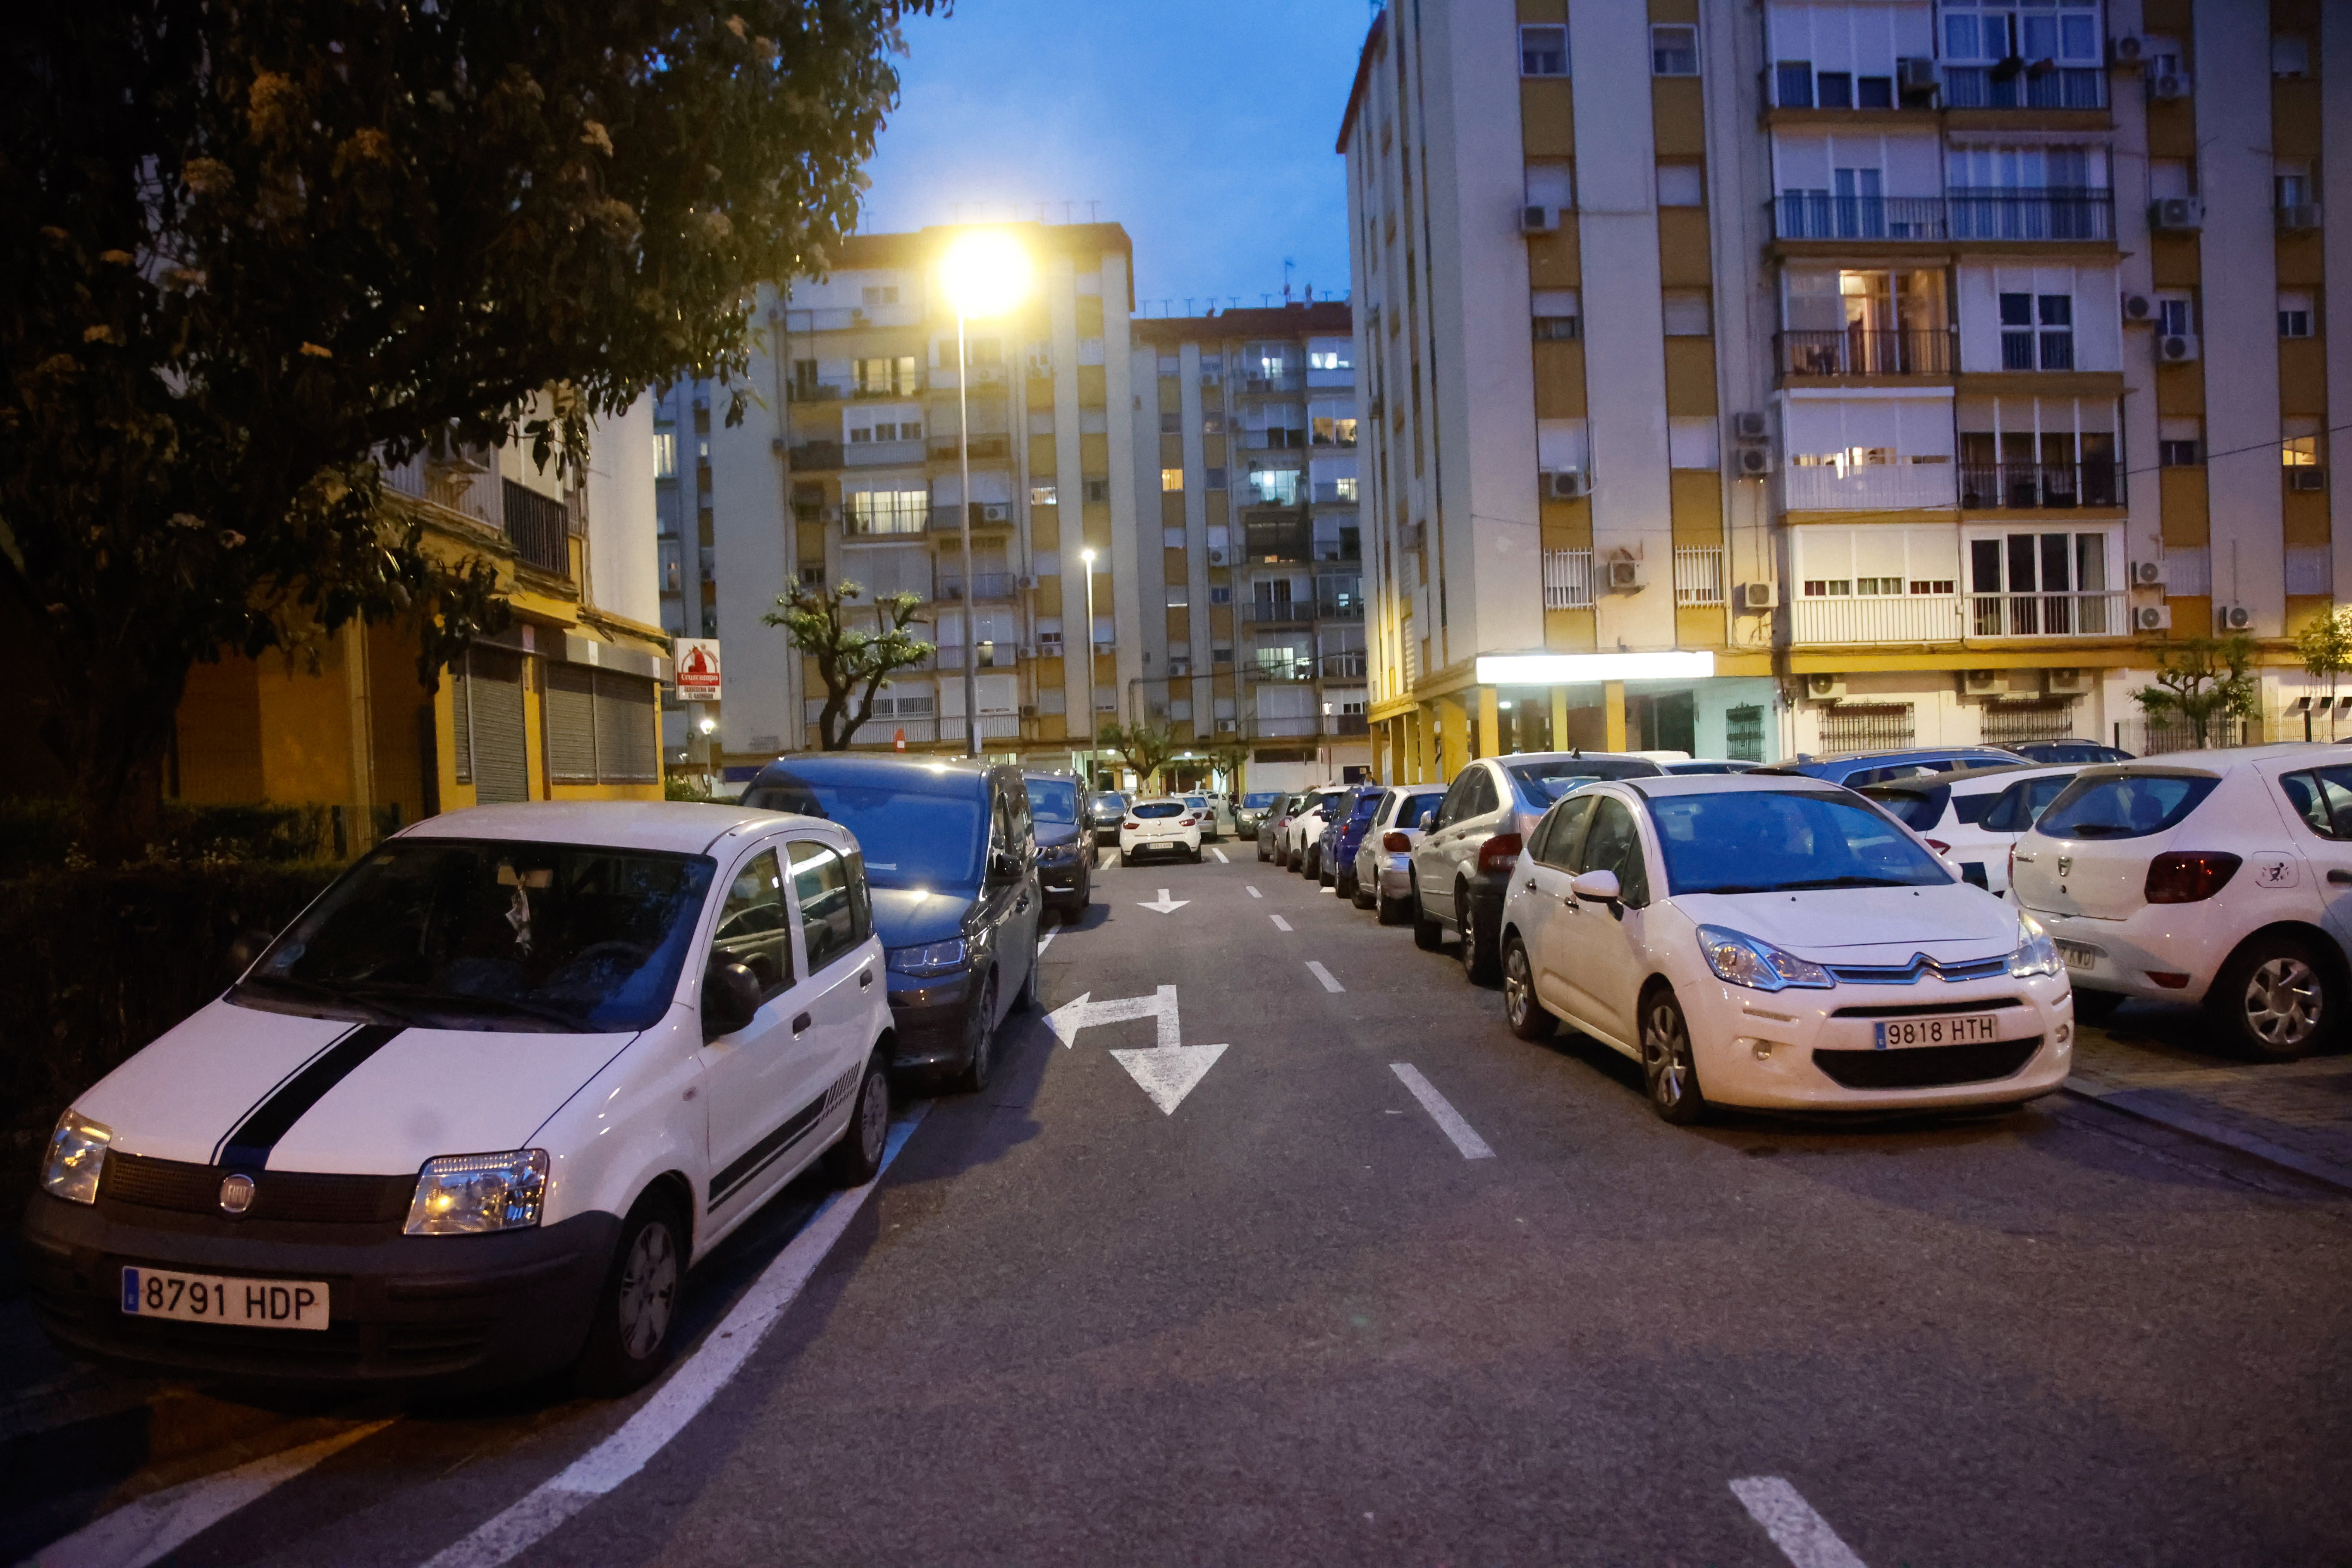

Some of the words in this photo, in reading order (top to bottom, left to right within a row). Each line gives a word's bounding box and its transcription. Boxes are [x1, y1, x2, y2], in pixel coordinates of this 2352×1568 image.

[681, 674, 718, 683] Cruzcampo
[1889, 1022, 1943, 1044] 9818
[1952, 1018, 1993, 1041] HTH
[227, 1185, 249, 1202] FIAT
[147, 1277, 224, 1316] 8791
[246, 1286, 315, 1321] HDP
